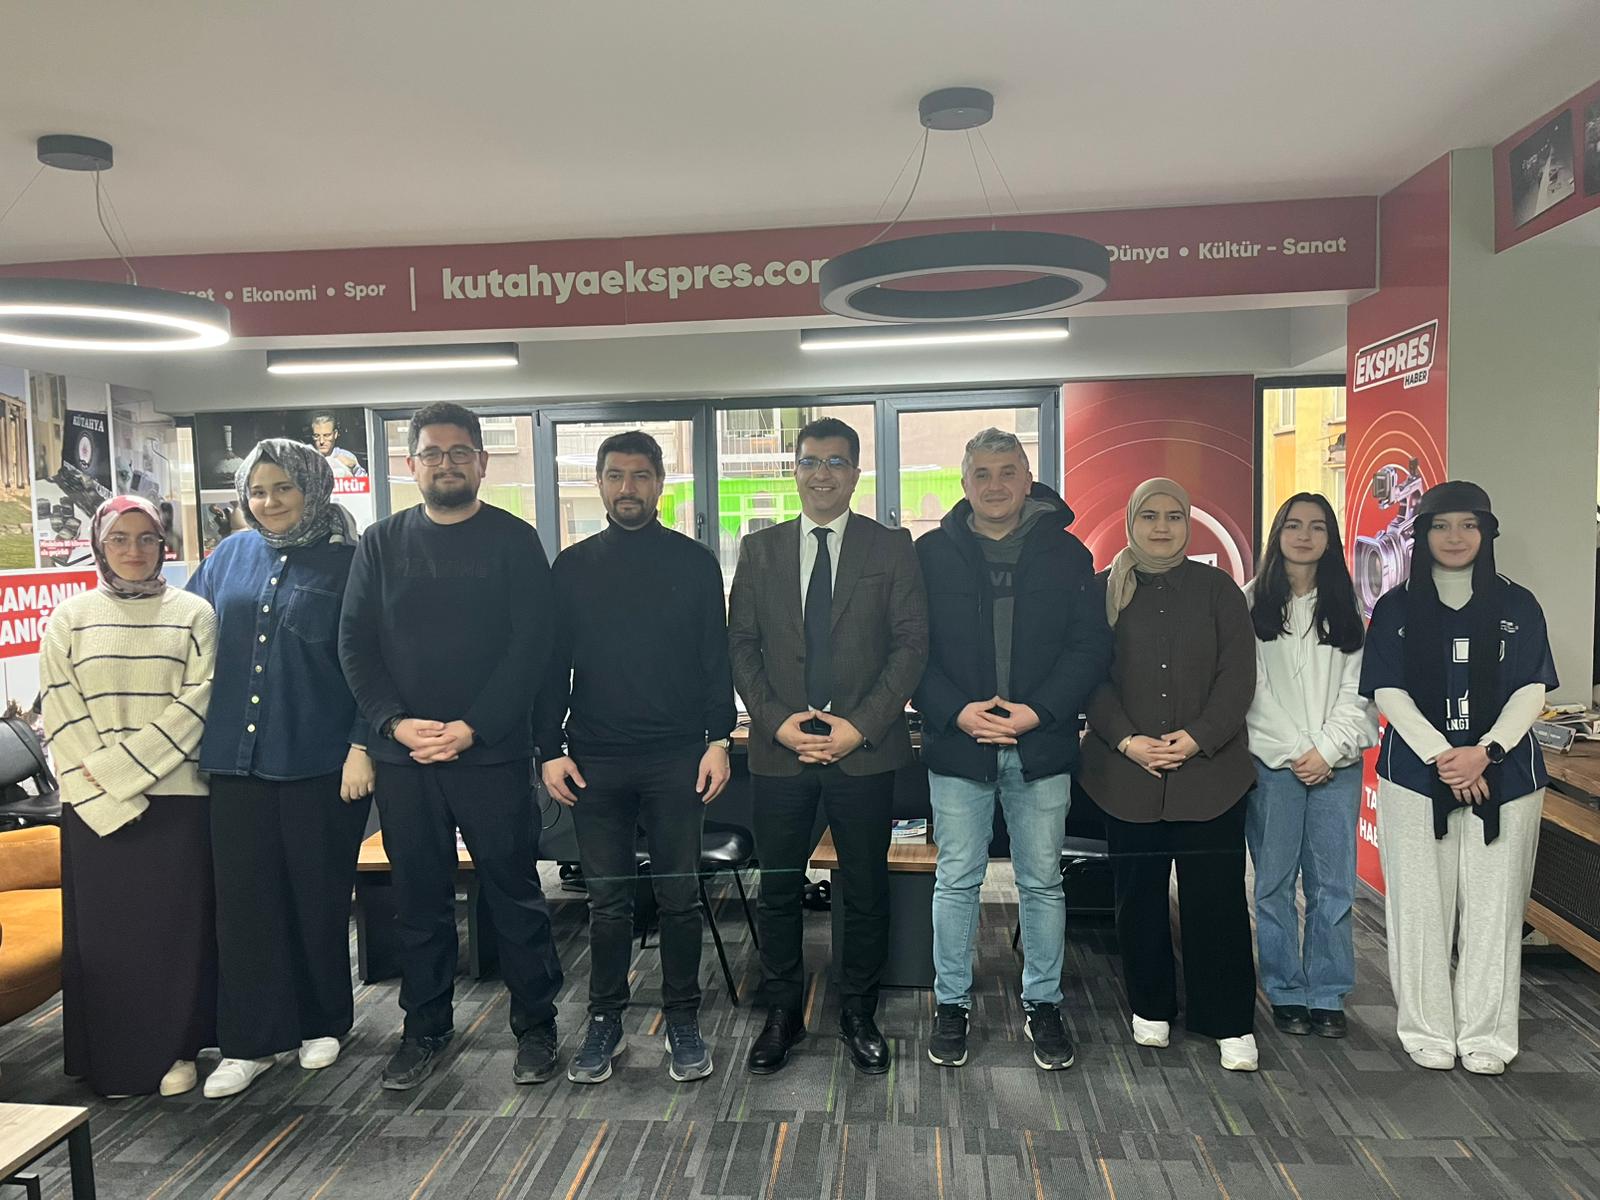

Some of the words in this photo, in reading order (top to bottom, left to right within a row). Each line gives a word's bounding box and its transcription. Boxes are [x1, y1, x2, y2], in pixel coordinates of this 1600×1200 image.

[1199, 240, 1261, 260] Kültür
[1282, 236, 1346, 255] Sanat
[242, 285, 317, 302] Ekonomi
[344, 281, 386, 301] Spor
[1356, 334, 1429, 384] EKSPRES
[1405, 371, 1427, 385] HABER
[0, 582, 87, 612] AMANIN
